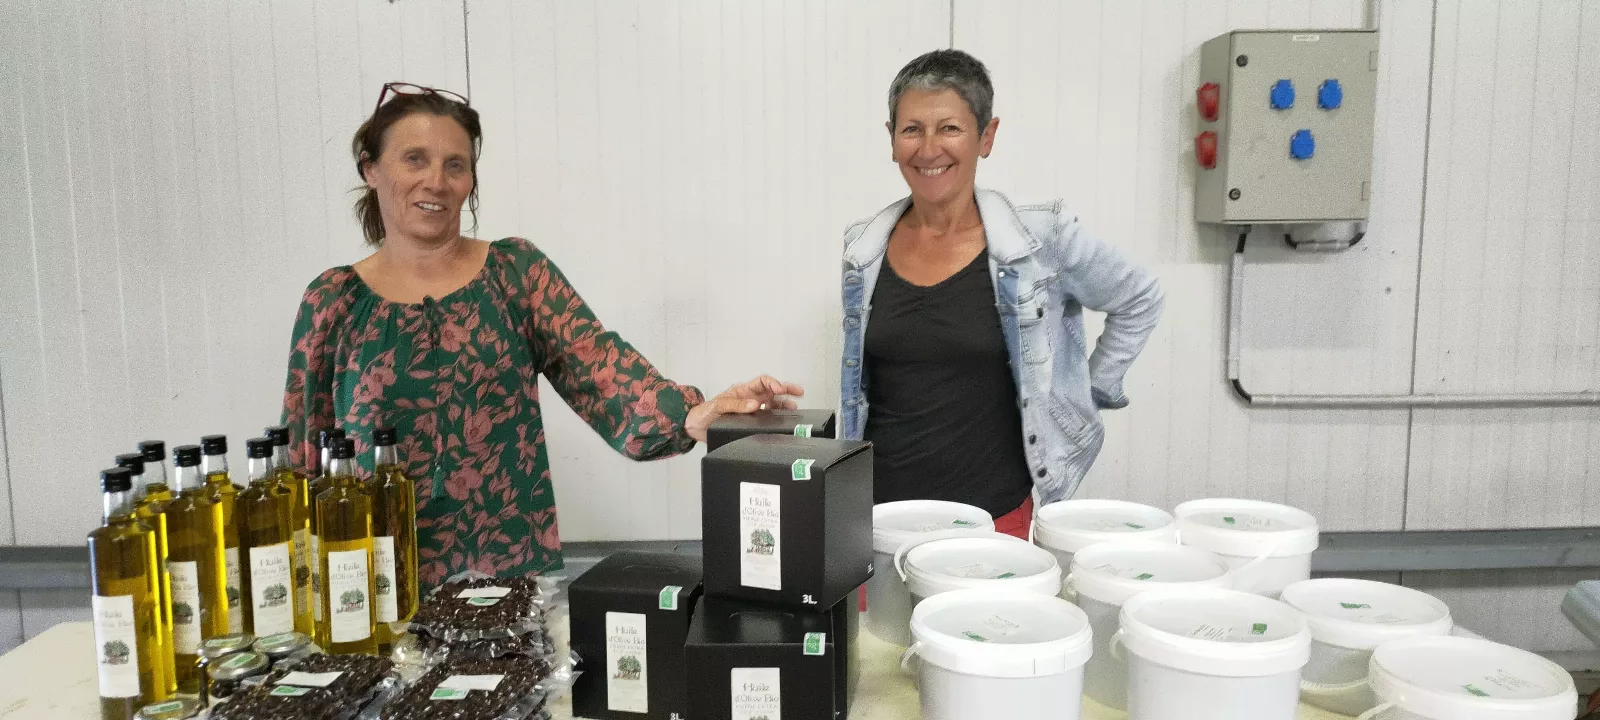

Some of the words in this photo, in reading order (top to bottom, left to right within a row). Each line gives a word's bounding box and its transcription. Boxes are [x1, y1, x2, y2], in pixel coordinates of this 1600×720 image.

[749, 497, 772, 507] Huile
[766, 508, 779, 518] Bio
[337, 562, 360, 571] Huile
[615, 625, 638, 634] Huile
[633, 636, 646, 645] Bio
[743, 682, 770, 692] Huile
[764, 693, 779, 702] Bio
